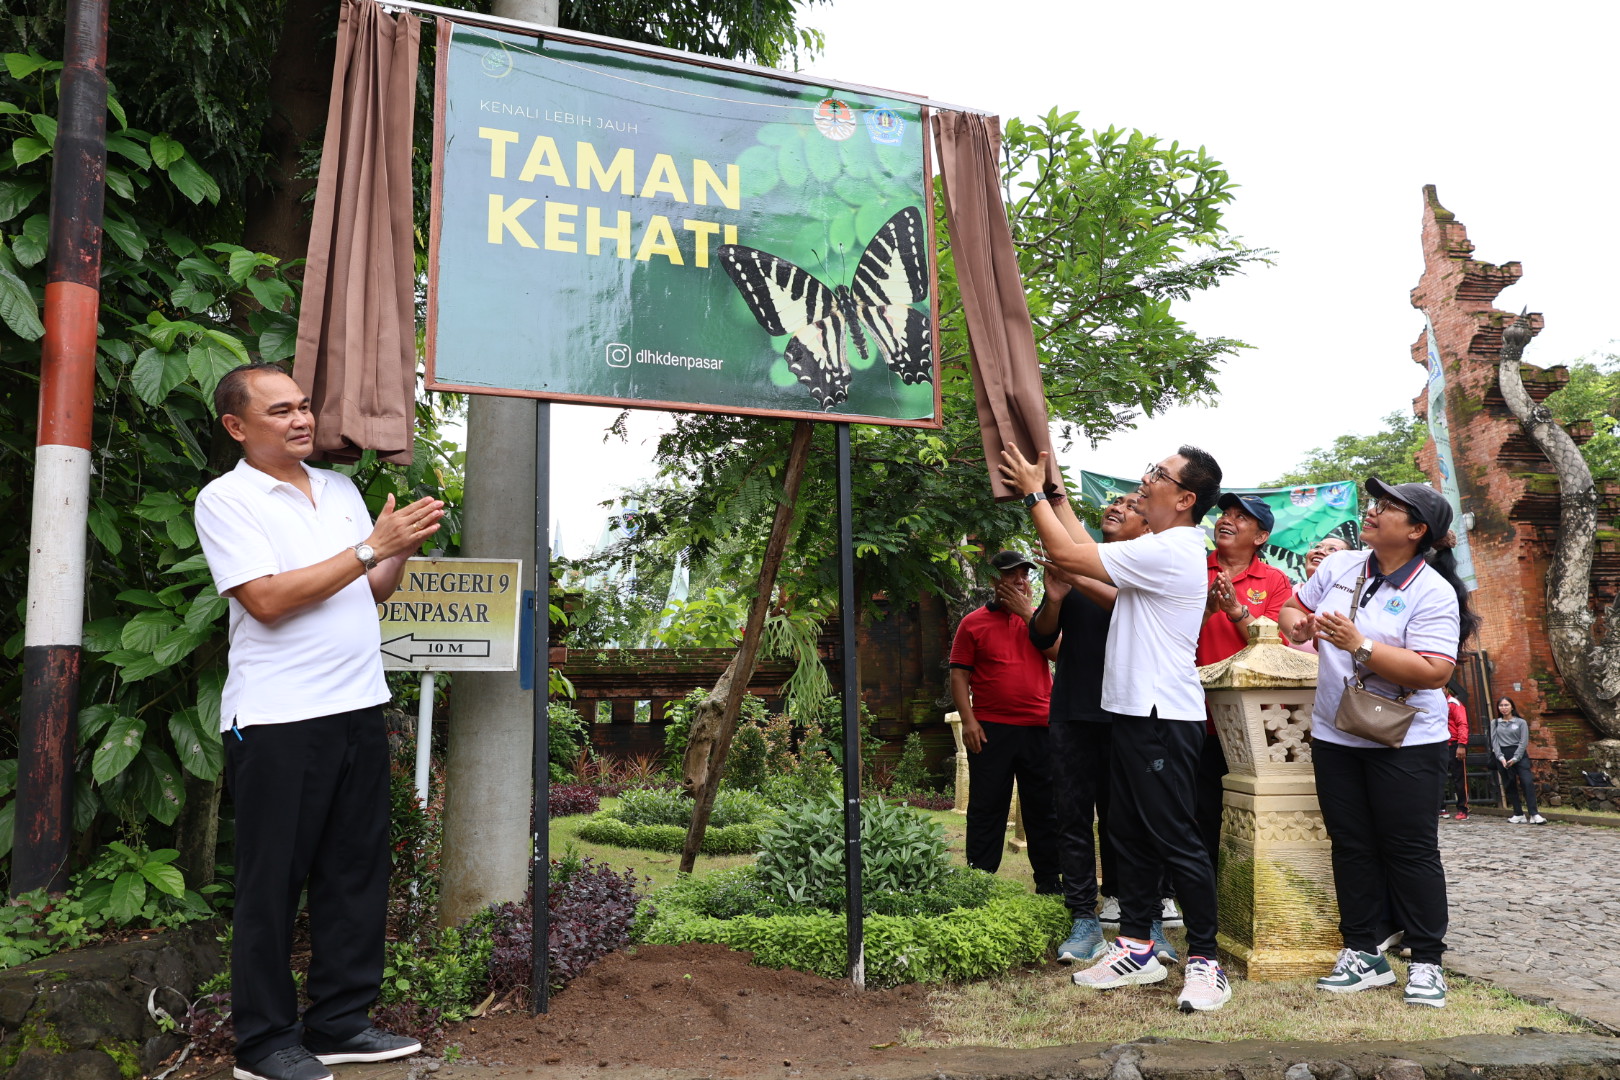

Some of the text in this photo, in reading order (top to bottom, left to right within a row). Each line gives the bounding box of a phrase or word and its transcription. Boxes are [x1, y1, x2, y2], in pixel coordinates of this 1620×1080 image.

[480, 99, 639, 135] KENALI LEBIH JAUH
[478, 126, 740, 210] TAMAN
[635, 349, 723, 371] dlhkdenpasar
[409, 572, 494, 593] NEGERI
[499, 574, 510, 593] 9
[376, 602, 490, 623] DENPASAR
[428, 643, 464, 653] 10 M
